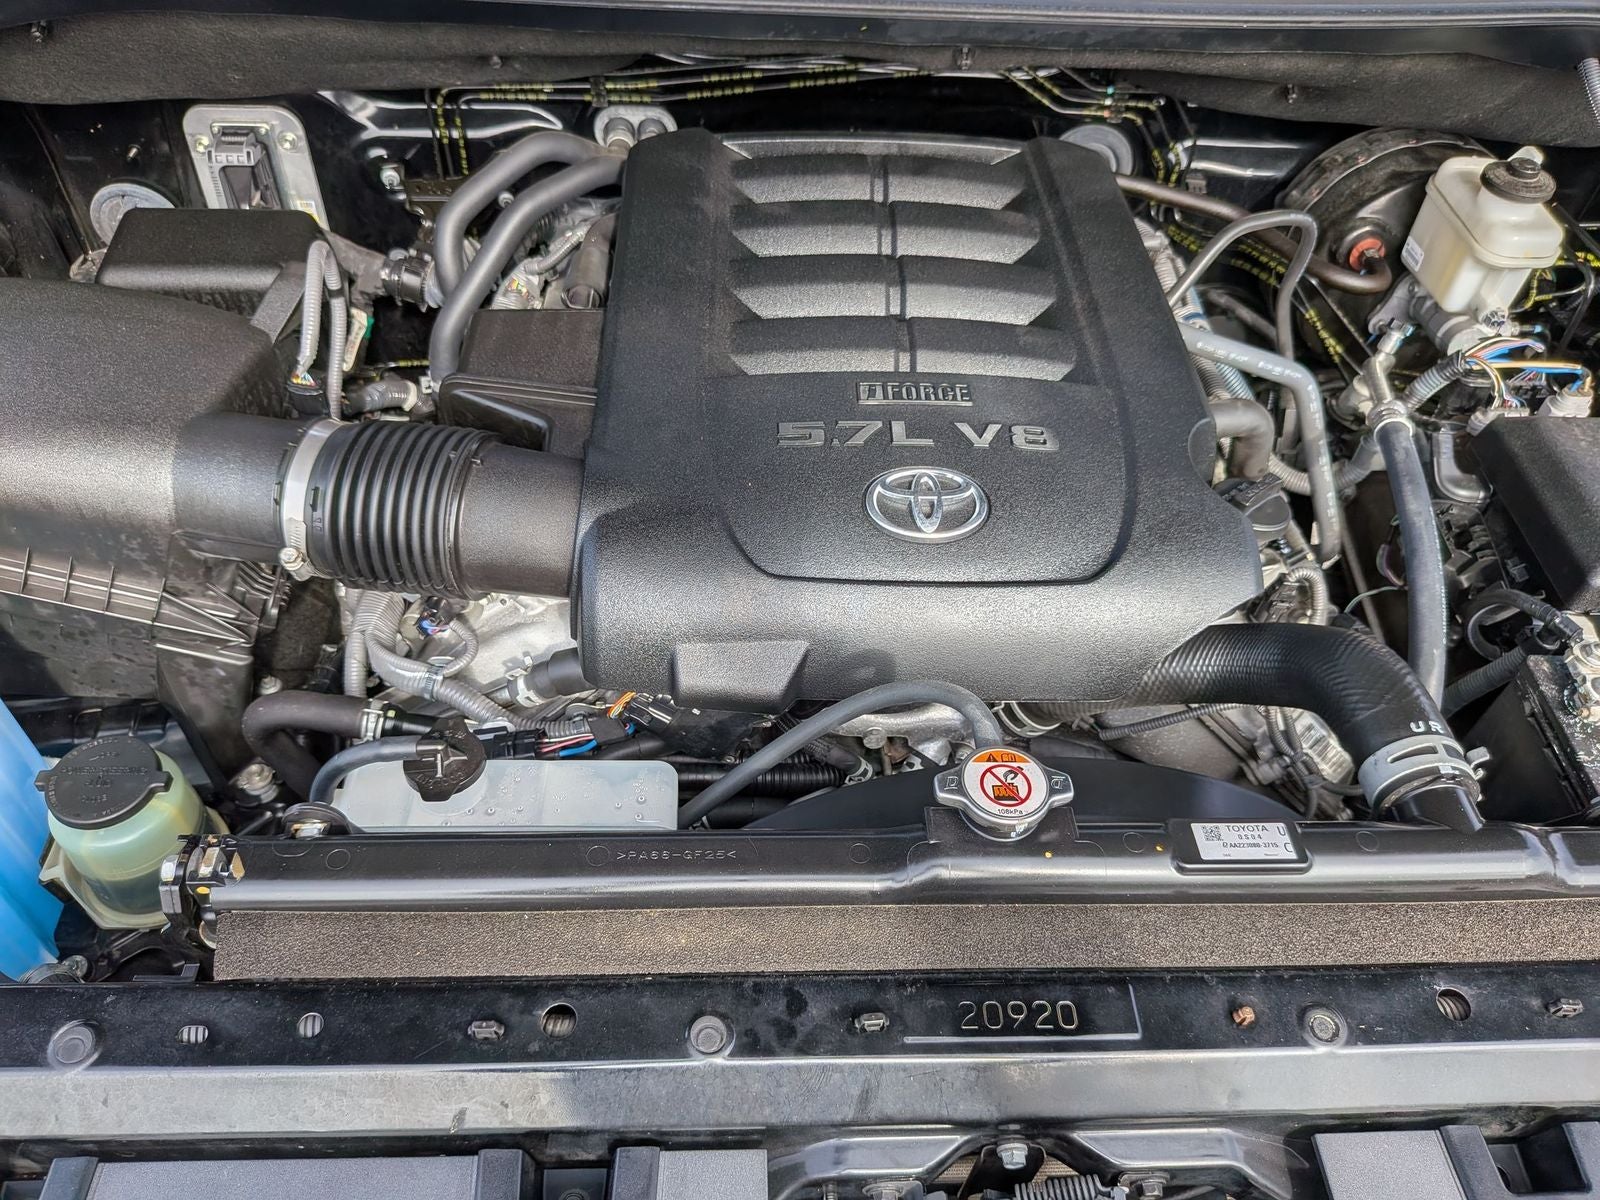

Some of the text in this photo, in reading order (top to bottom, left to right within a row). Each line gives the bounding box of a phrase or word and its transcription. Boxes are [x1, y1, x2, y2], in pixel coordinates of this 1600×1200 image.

[777, 420, 1060, 451] 5.7L V8
[1225, 824, 1269, 833] TOYOTA
[1276, 825, 1287, 836] U
[1283, 842, 1293, 853] C
[958, 1000, 1080, 1030] 20920
